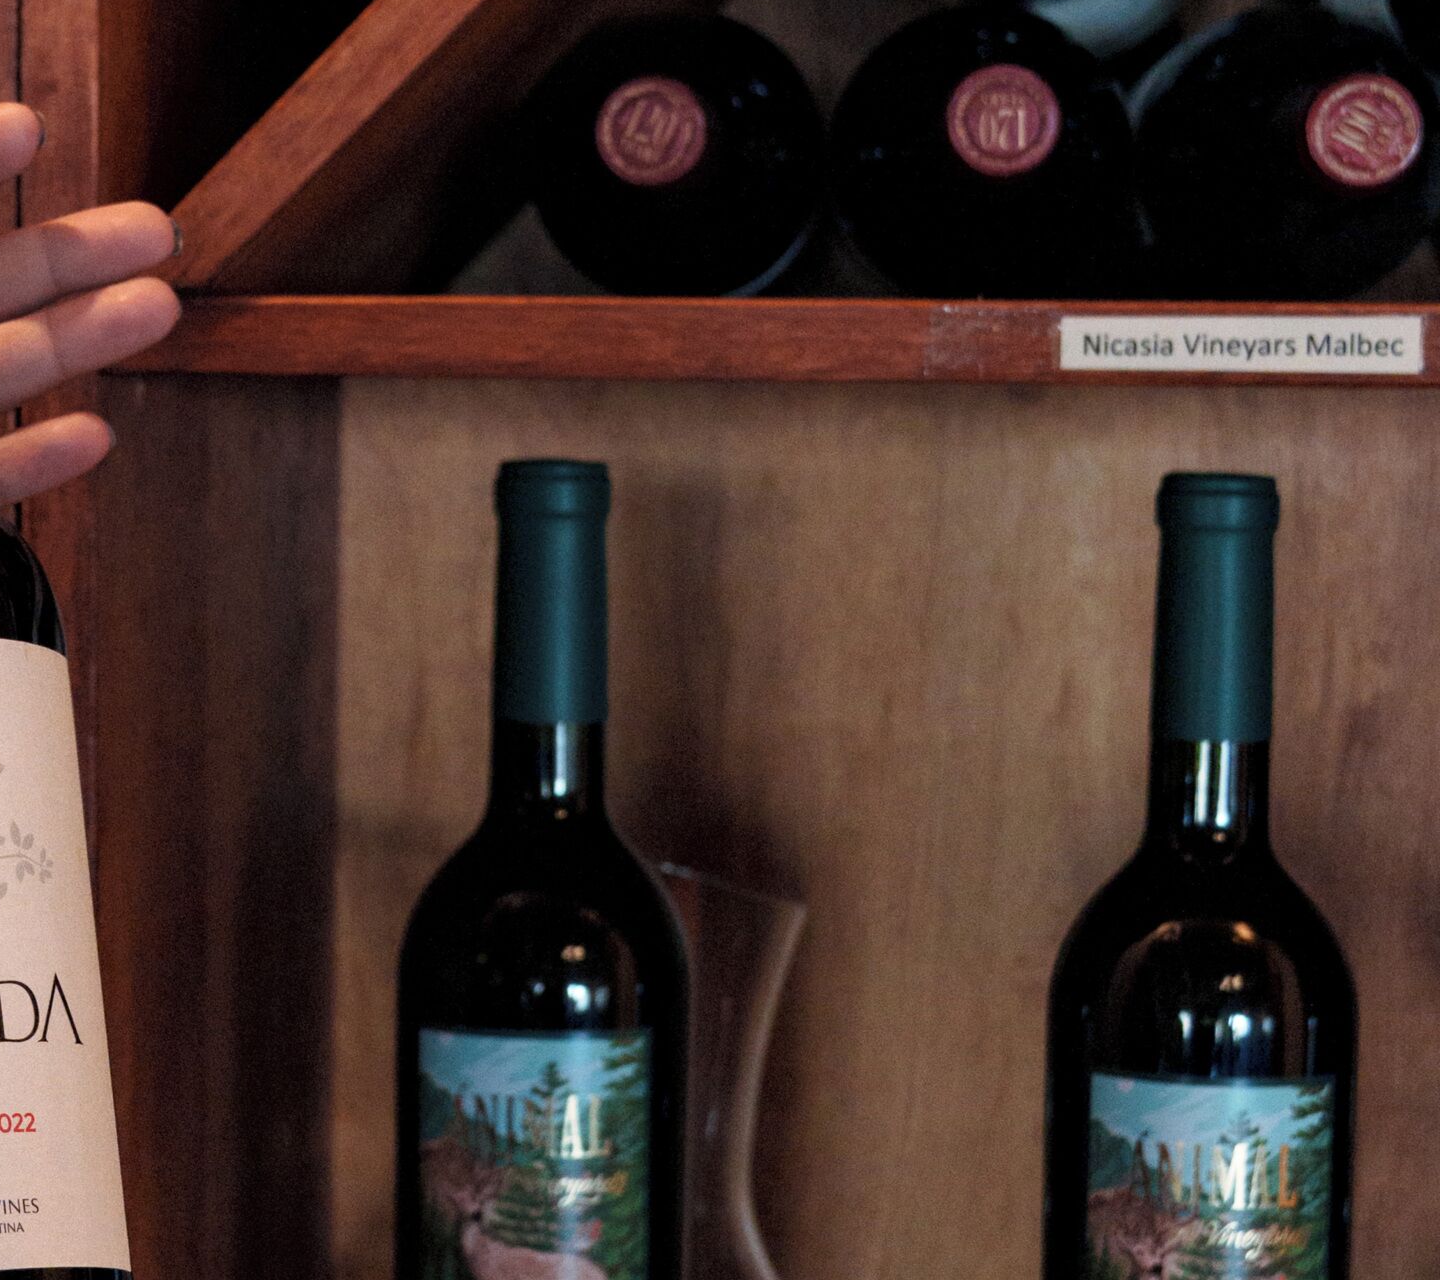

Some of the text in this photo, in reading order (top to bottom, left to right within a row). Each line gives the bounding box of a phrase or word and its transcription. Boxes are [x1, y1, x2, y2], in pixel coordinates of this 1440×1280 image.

[1082, 333, 1404, 361] Nicasia Vineyars Malbec
[1132, 1138, 1298, 1211] ANIMAL
